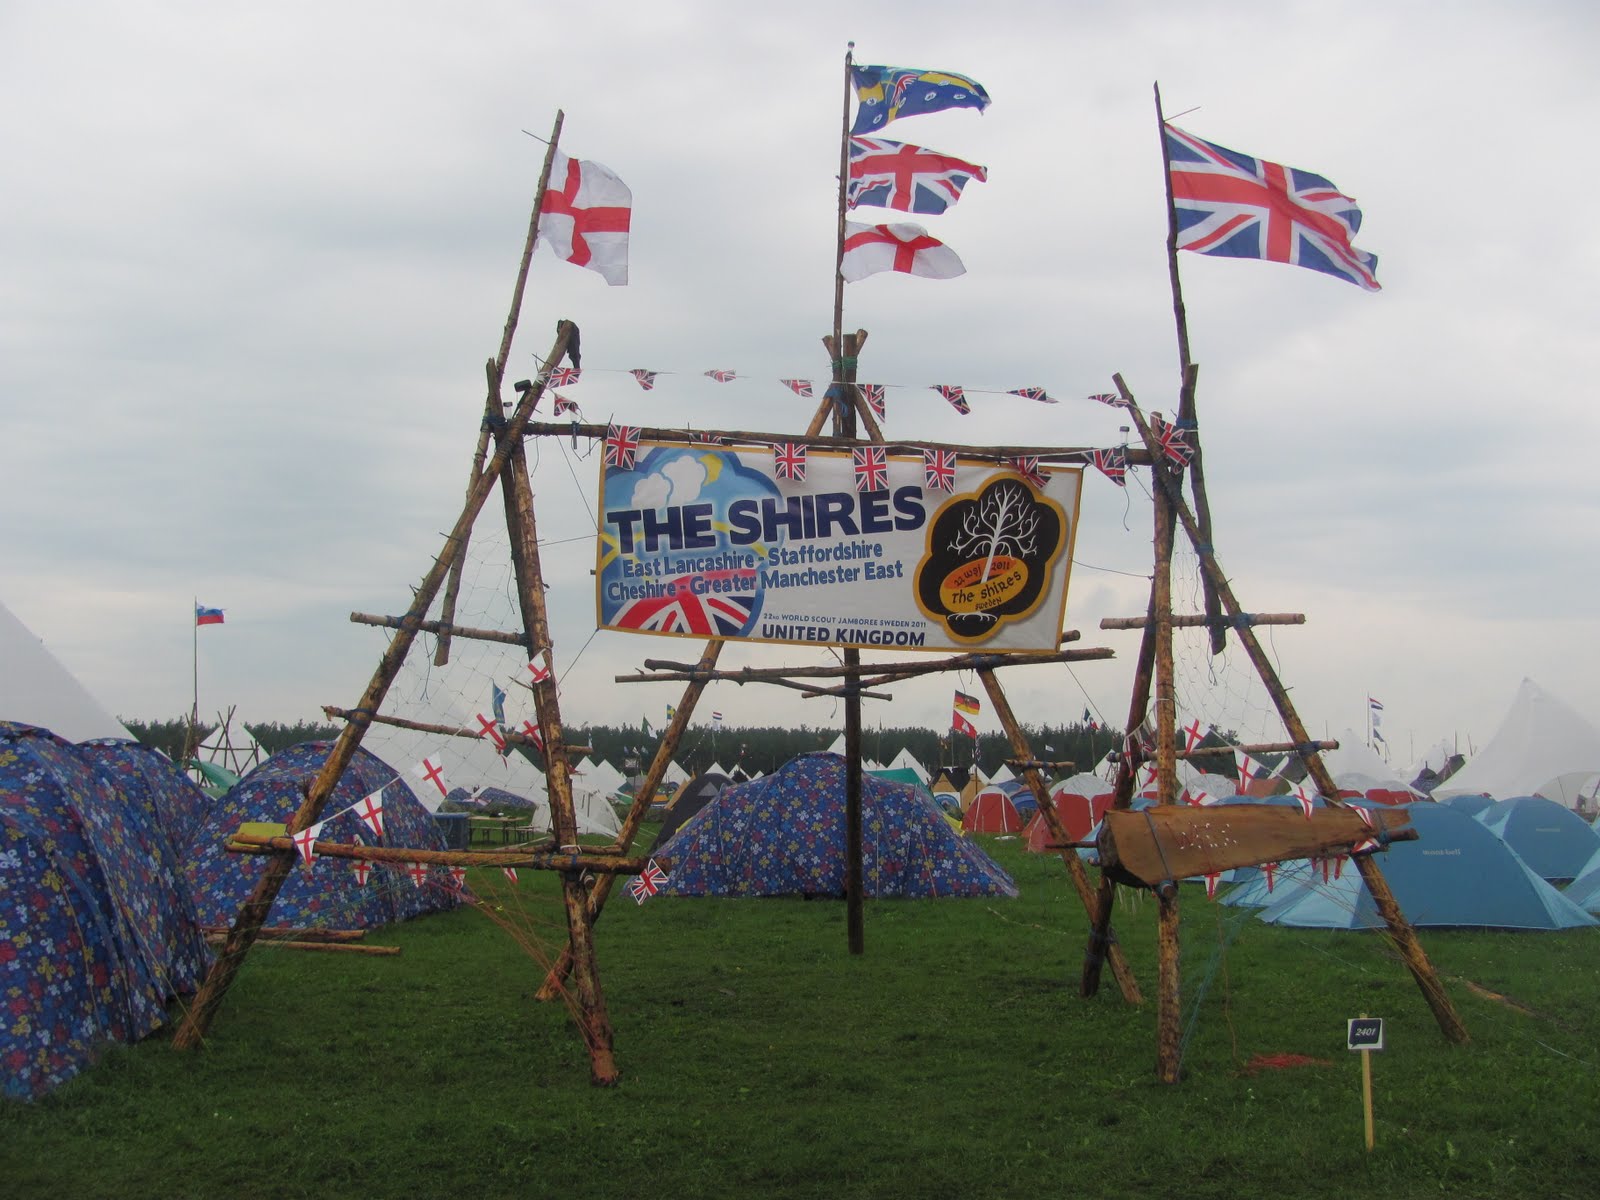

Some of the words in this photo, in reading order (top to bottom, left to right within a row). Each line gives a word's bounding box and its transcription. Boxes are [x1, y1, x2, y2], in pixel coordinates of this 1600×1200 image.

[607, 503, 716, 554] THE
[728, 486, 926, 546] SHIRES
[622, 558, 661, 578] East
[664, 551, 754, 574] Lancashire
[768, 540, 883, 567] Staffordshire
[991, 561, 1010, 571] 2011
[607, 579, 676, 601] Cheshire
[689, 574, 757, 597] Greater
[761, 567, 861, 590] Manchester
[864, 560, 904, 581] East
[952, 589, 975, 604] The
[980, 571, 1022, 599] shires
[762, 623, 830, 642] UNITED
[835, 628, 926, 647] KINGDOM
[781, 614, 810, 622] WORLD
[811, 615, 837, 624] SCOUT
[838, 617, 878, 626] JAMBOREE
[879, 619, 910, 628] SWEDEN
[911, 621, 927, 629] 2011
[1355, 1027, 1376, 1036] 2401
